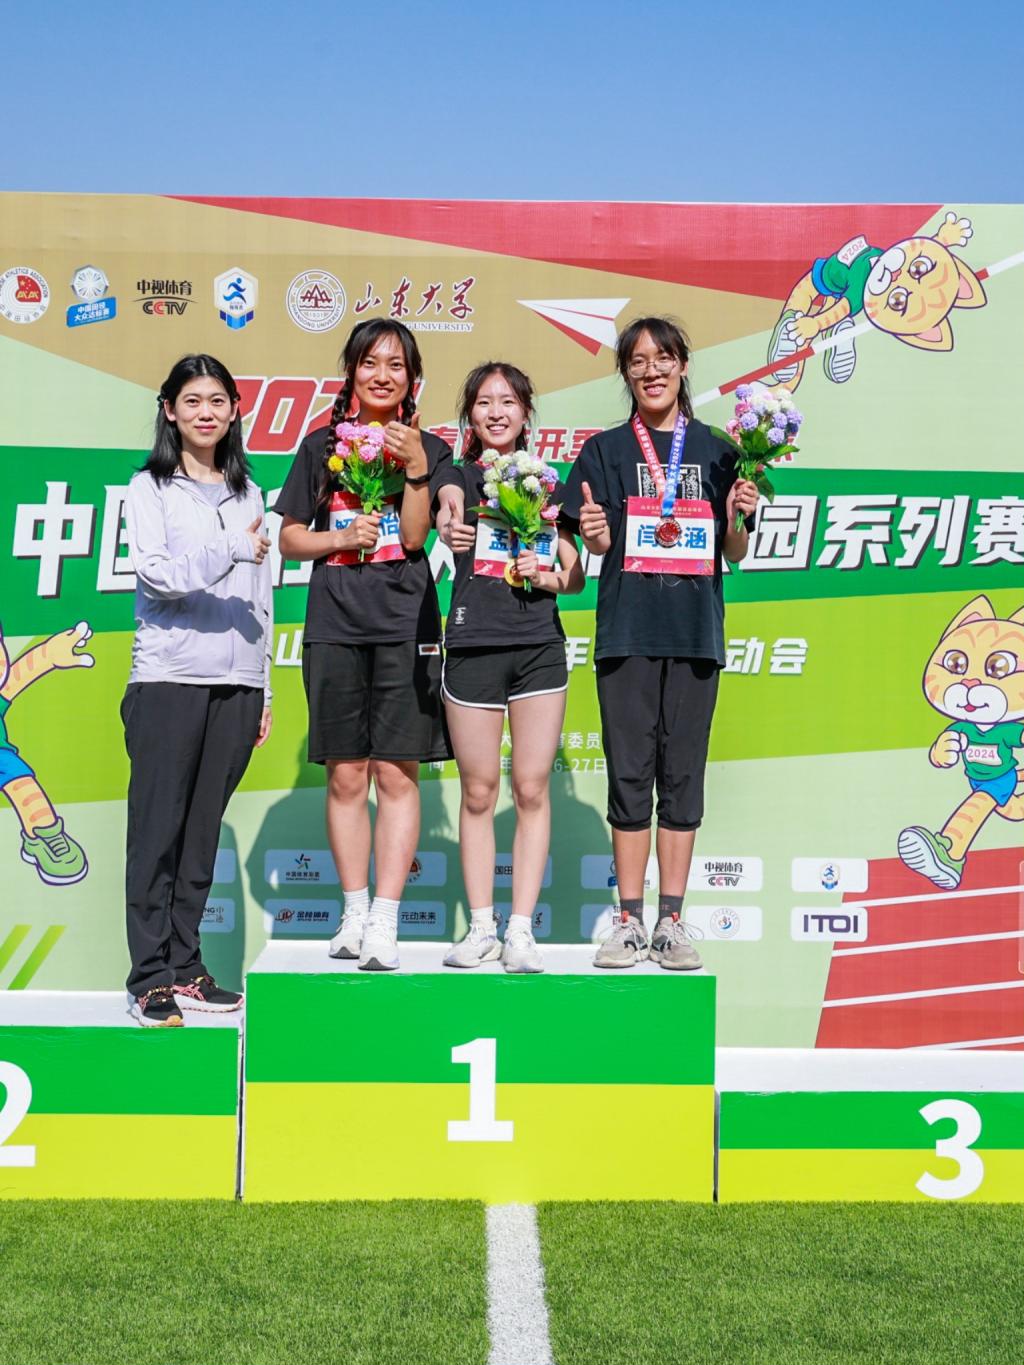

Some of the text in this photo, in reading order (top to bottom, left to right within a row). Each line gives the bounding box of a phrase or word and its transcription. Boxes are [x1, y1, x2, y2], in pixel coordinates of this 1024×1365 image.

[137, 279, 192, 296] 中视体育
[143, 301, 188, 315] CCTV
[355, 278, 475, 320] 山东大学
[414, 323, 472, 331] UNIVERSITY
[489, 527, 552, 556] 孟童
[637, 523, 707, 550] 闫涵
[967, 748, 996, 760] 2024
[708, 877, 740, 887] CCTV
[804, 915, 858, 933] ITOI
[447, 1038, 513, 1141] 1
[915, 1099, 982, 1199] 3
